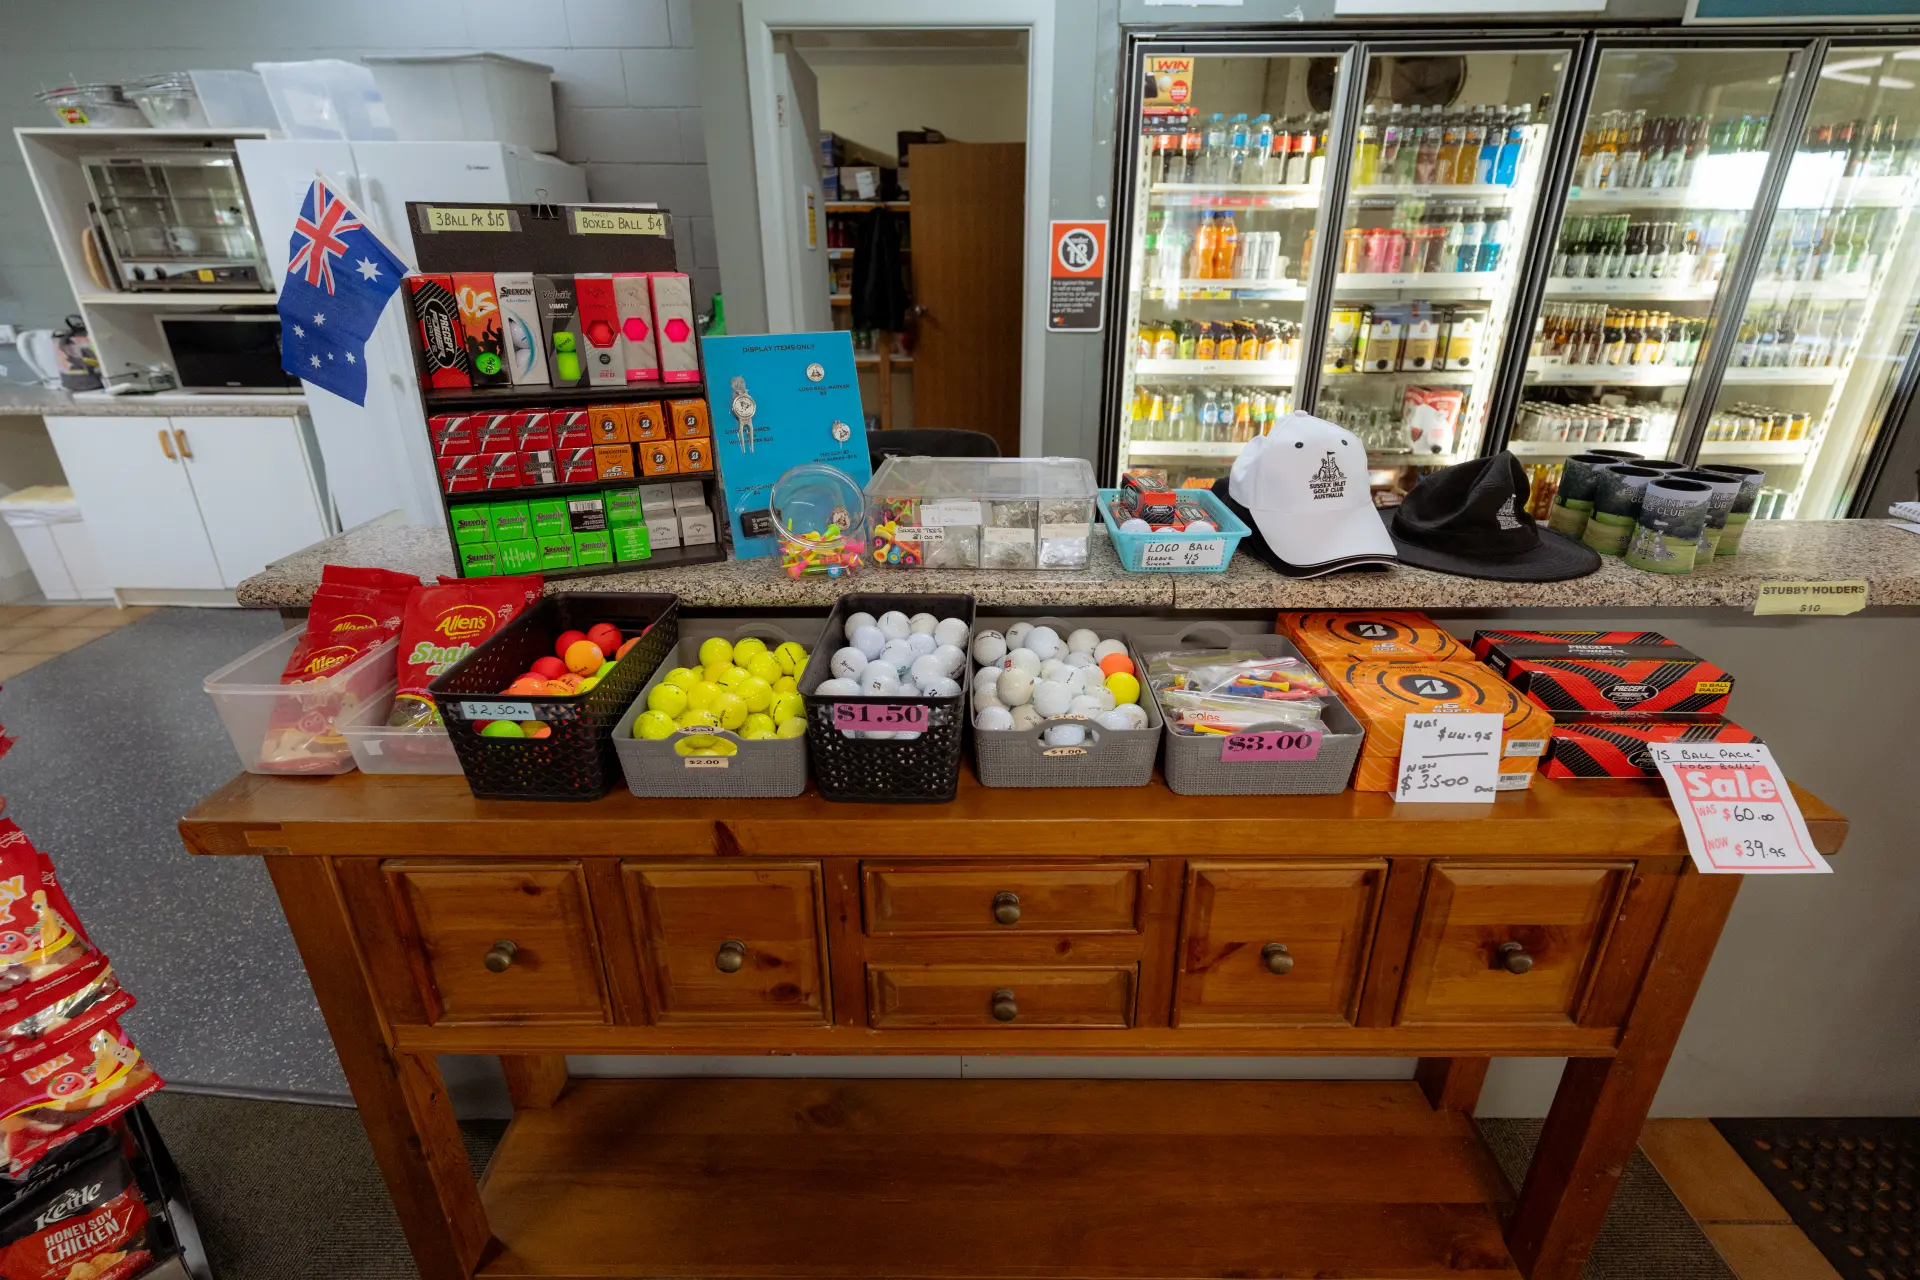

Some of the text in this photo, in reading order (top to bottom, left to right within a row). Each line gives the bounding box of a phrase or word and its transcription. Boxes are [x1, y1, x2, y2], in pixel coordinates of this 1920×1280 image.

[1158, 61, 1190, 70] WIN
[487, 212, 505, 227] $15
[582, 216, 662, 230] BOXED BALL $4
[1067, 243, 1088, 264] 18
[500, 287, 533, 297] SRIXON
[425, 315, 438, 352] DRIVE
[429, 309, 446, 359] POWER
[438, 313, 455, 354] PRECEPT
[742, 345, 772, 354] DISPLAY
[774, 344, 795, 352] ITEMS
[1332, 480, 1346, 488] INLET
[1313, 492, 1344, 500] AUSTRALIA
[1656, 507, 1686, 516] CLUB
[1148, 543, 1215, 552] LOGO BALL
[1763, 585, 1865, 595] STUBBY HOLDERS
[1799, 604, 1821, 612] $10
[435, 614, 487, 636] Allen's
[468, 703, 516, 716] $2.50
[837, 704, 923, 723] $1.50
[1188, 711, 1221, 722] coles
[1438, 727, 1493, 741] $44.95
[1227, 734, 1313, 752] $3.00
[1681, 749, 1715, 759] BALL
[1719, 749, 1754, 759] PACK
[1686, 770, 1777, 799] Sale
[1696, 804, 1717, 817] WAS
[1706, 837, 1729, 850] NOW
[21, 1052, 74, 1085] MIX
[34, 1181, 103, 1232] Kettle
[44, 1210, 112, 1248] HONEY SOY
[47, 1218, 120, 1265] CHICKEN
